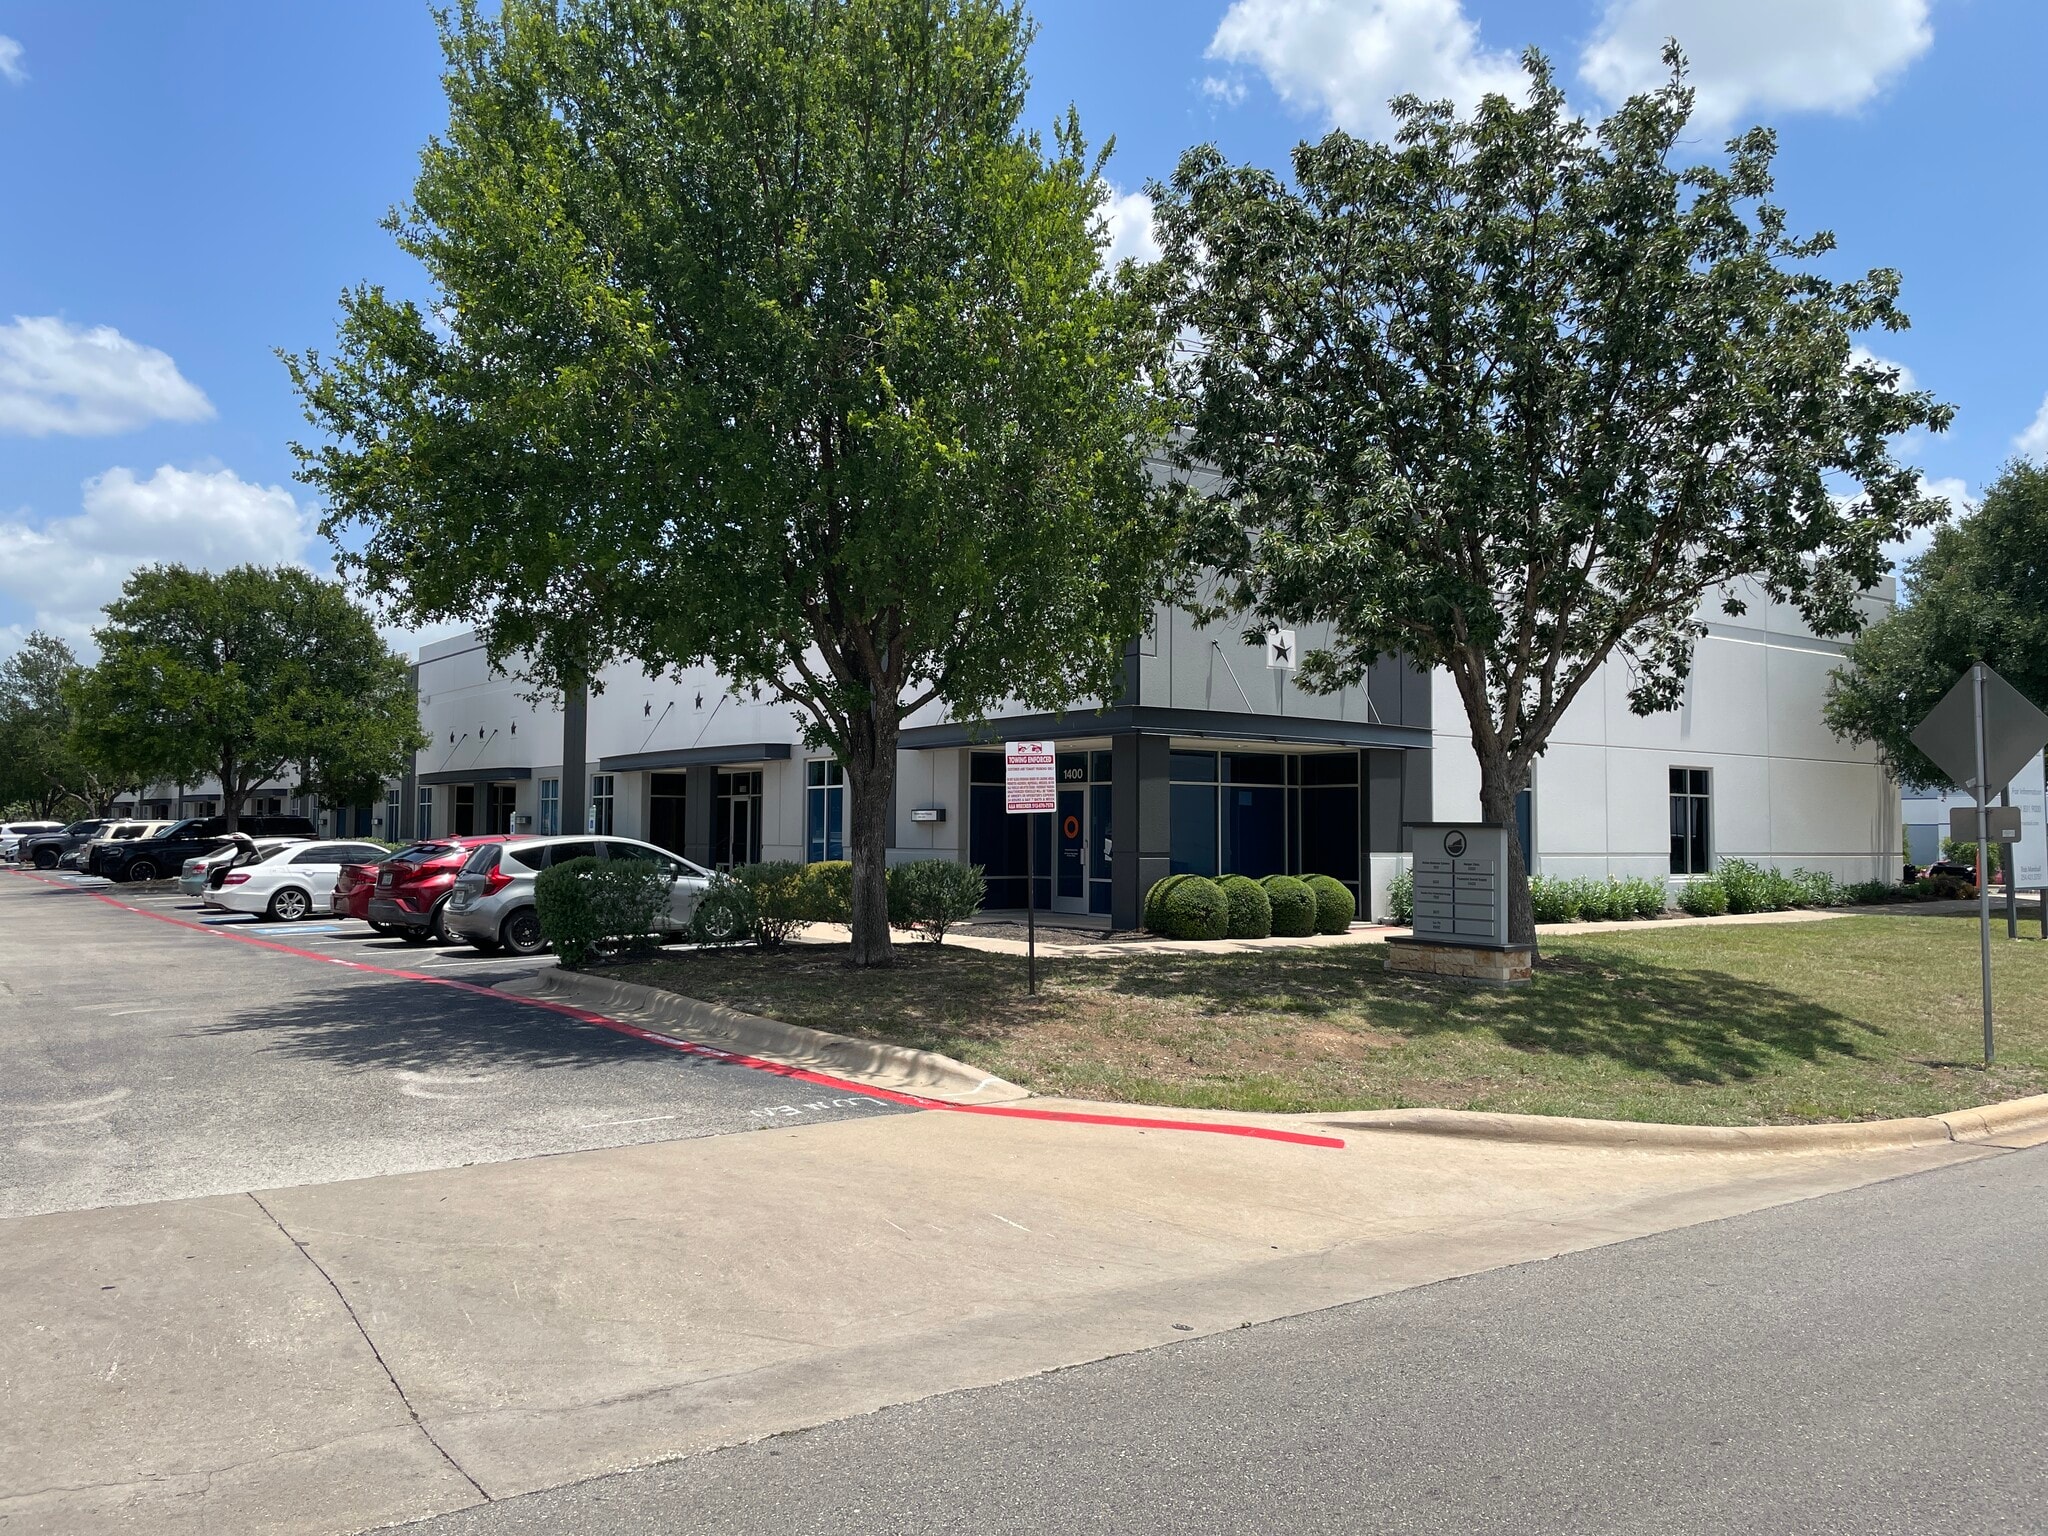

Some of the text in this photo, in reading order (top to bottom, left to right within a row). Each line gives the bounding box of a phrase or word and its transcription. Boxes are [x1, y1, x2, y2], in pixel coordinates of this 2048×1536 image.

[1008, 755, 1052, 764] TOWING ENFORCED
[1064, 768, 1083, 780] 1400
